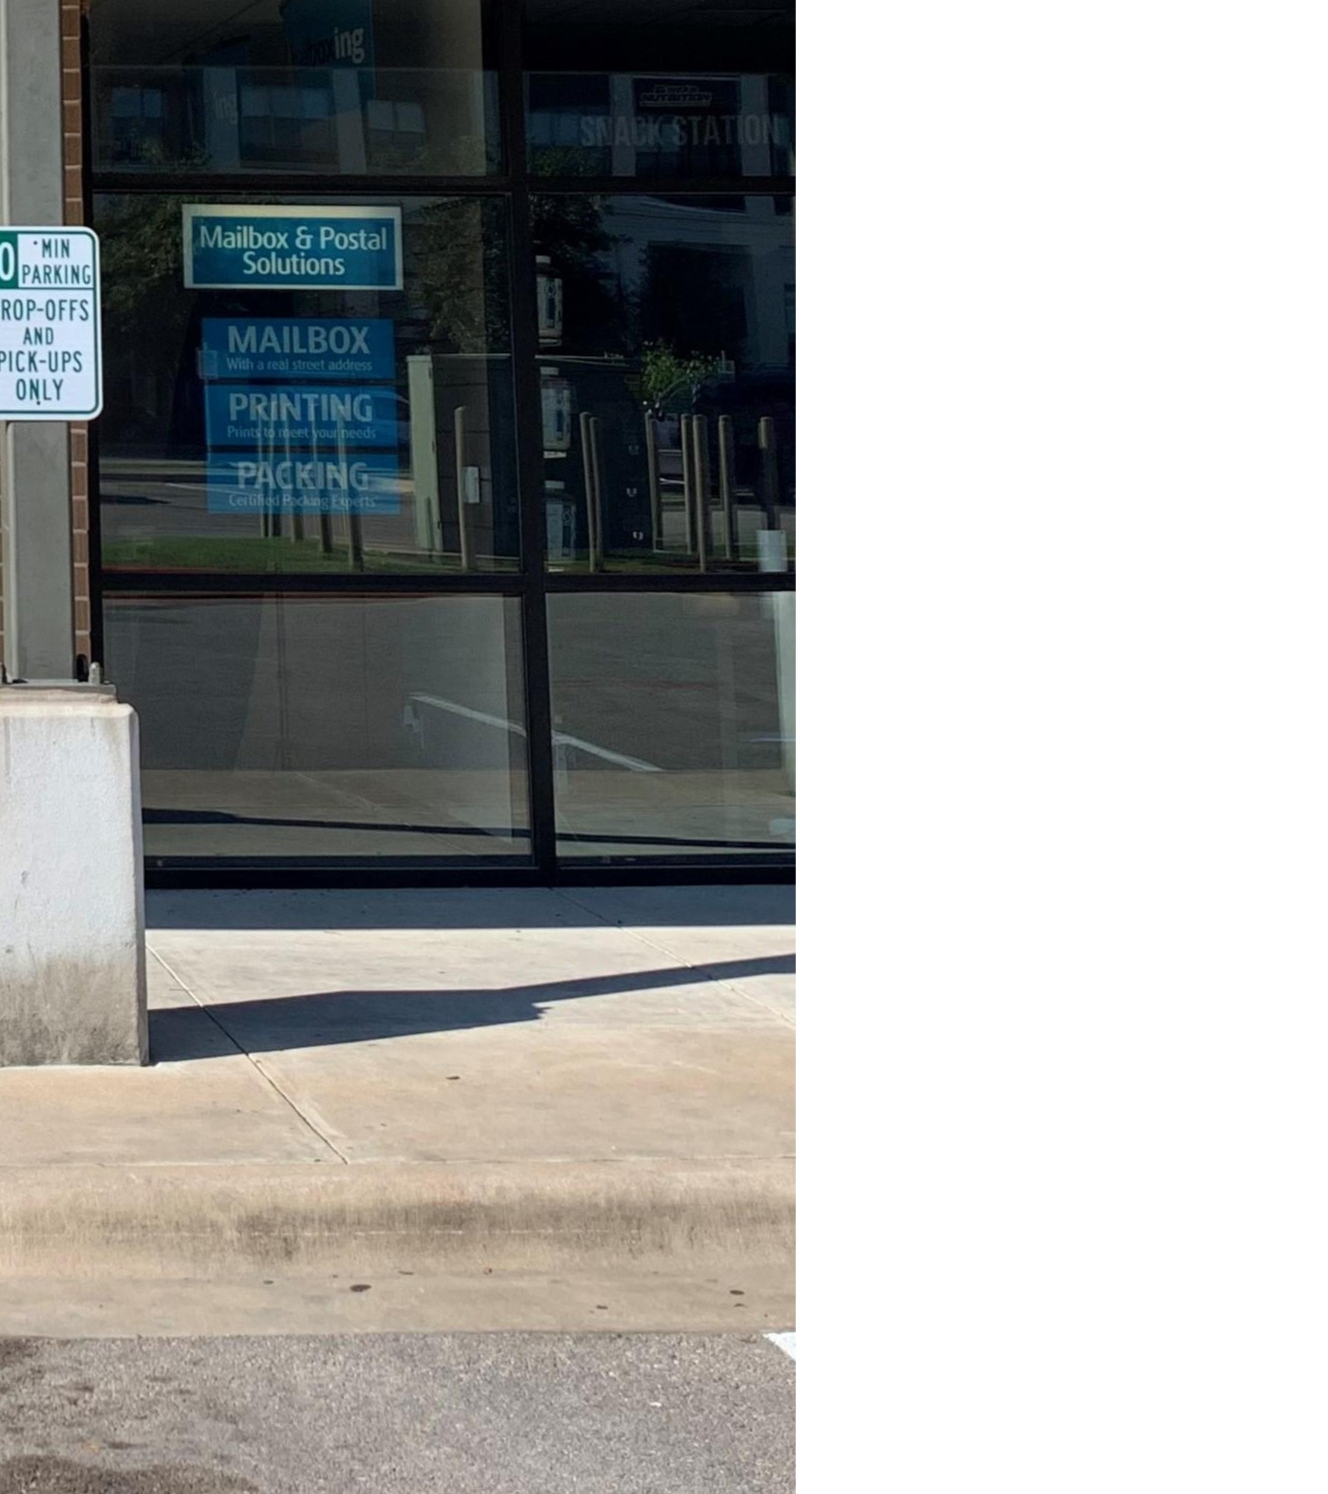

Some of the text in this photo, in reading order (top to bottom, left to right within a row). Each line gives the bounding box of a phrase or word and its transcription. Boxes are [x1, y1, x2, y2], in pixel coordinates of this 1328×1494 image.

[40, 237, 71, 261] MIN
[200, 226, 387, 251] Mailbox & Postal
[21, 263, 92, 286] PARKING
[243, 251, 346, 276] Solutions
[22, 326, 55, 346] AND
[228, 326, 370, 354] MAILBOX
[227, 357, 373, 371] With a real street address
[15, 377, 64, 402] ONLY
[229, 392, 373, 423] PRINTING
[227, 425, 376, 441] Prints to meet your needs
[237, 461, 369, 491] PACKING
[228, 494, 280, 508] Certified
[282, 494, 329, 509] Packing
